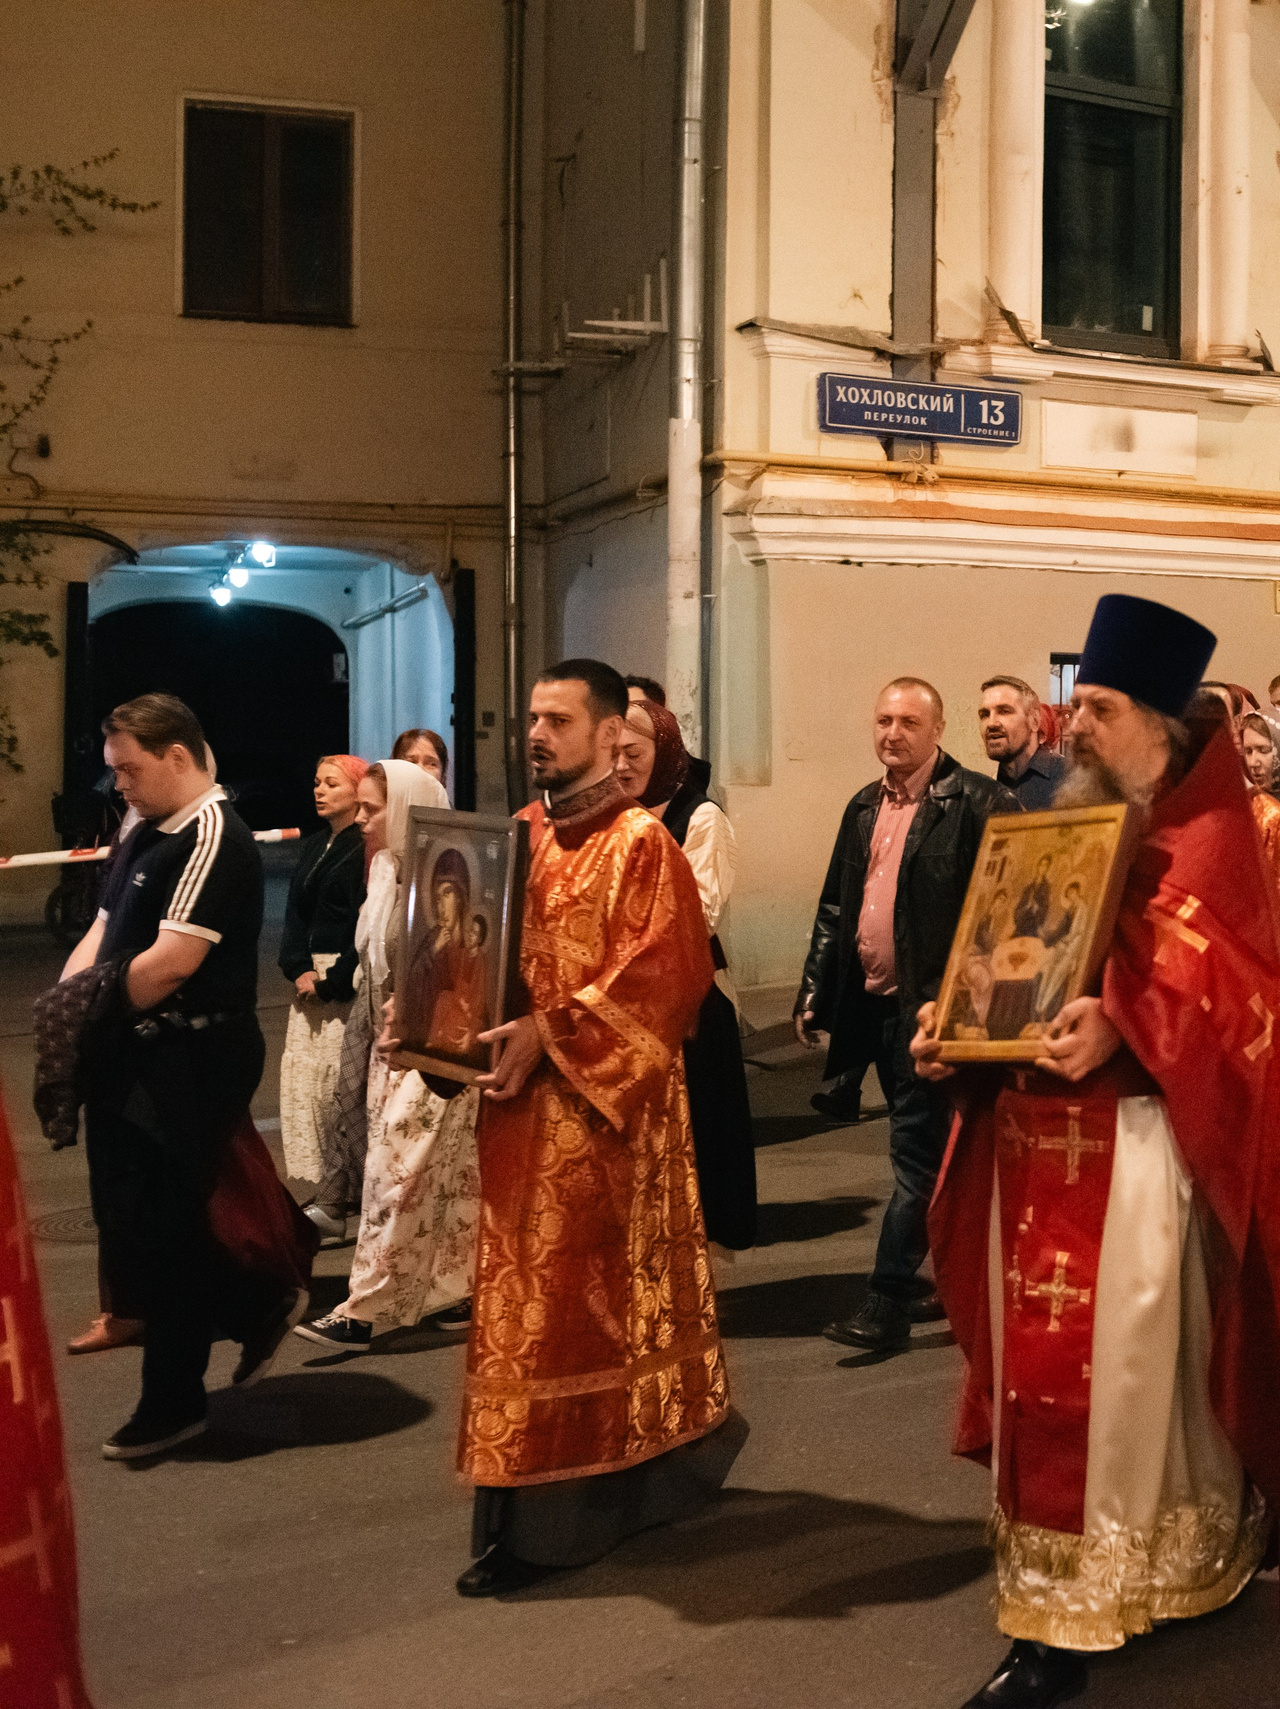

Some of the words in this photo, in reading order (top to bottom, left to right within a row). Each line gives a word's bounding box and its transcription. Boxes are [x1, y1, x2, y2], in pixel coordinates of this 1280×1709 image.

[836, 385, 954, 413] ХОХЛОВСКИЙ
[864, 411, 928, 426] ПЕРЕУЛОК
[979, 400, 1005, 426] 13
[967, 427, 1010, 437] СТРОЕНИЕ
